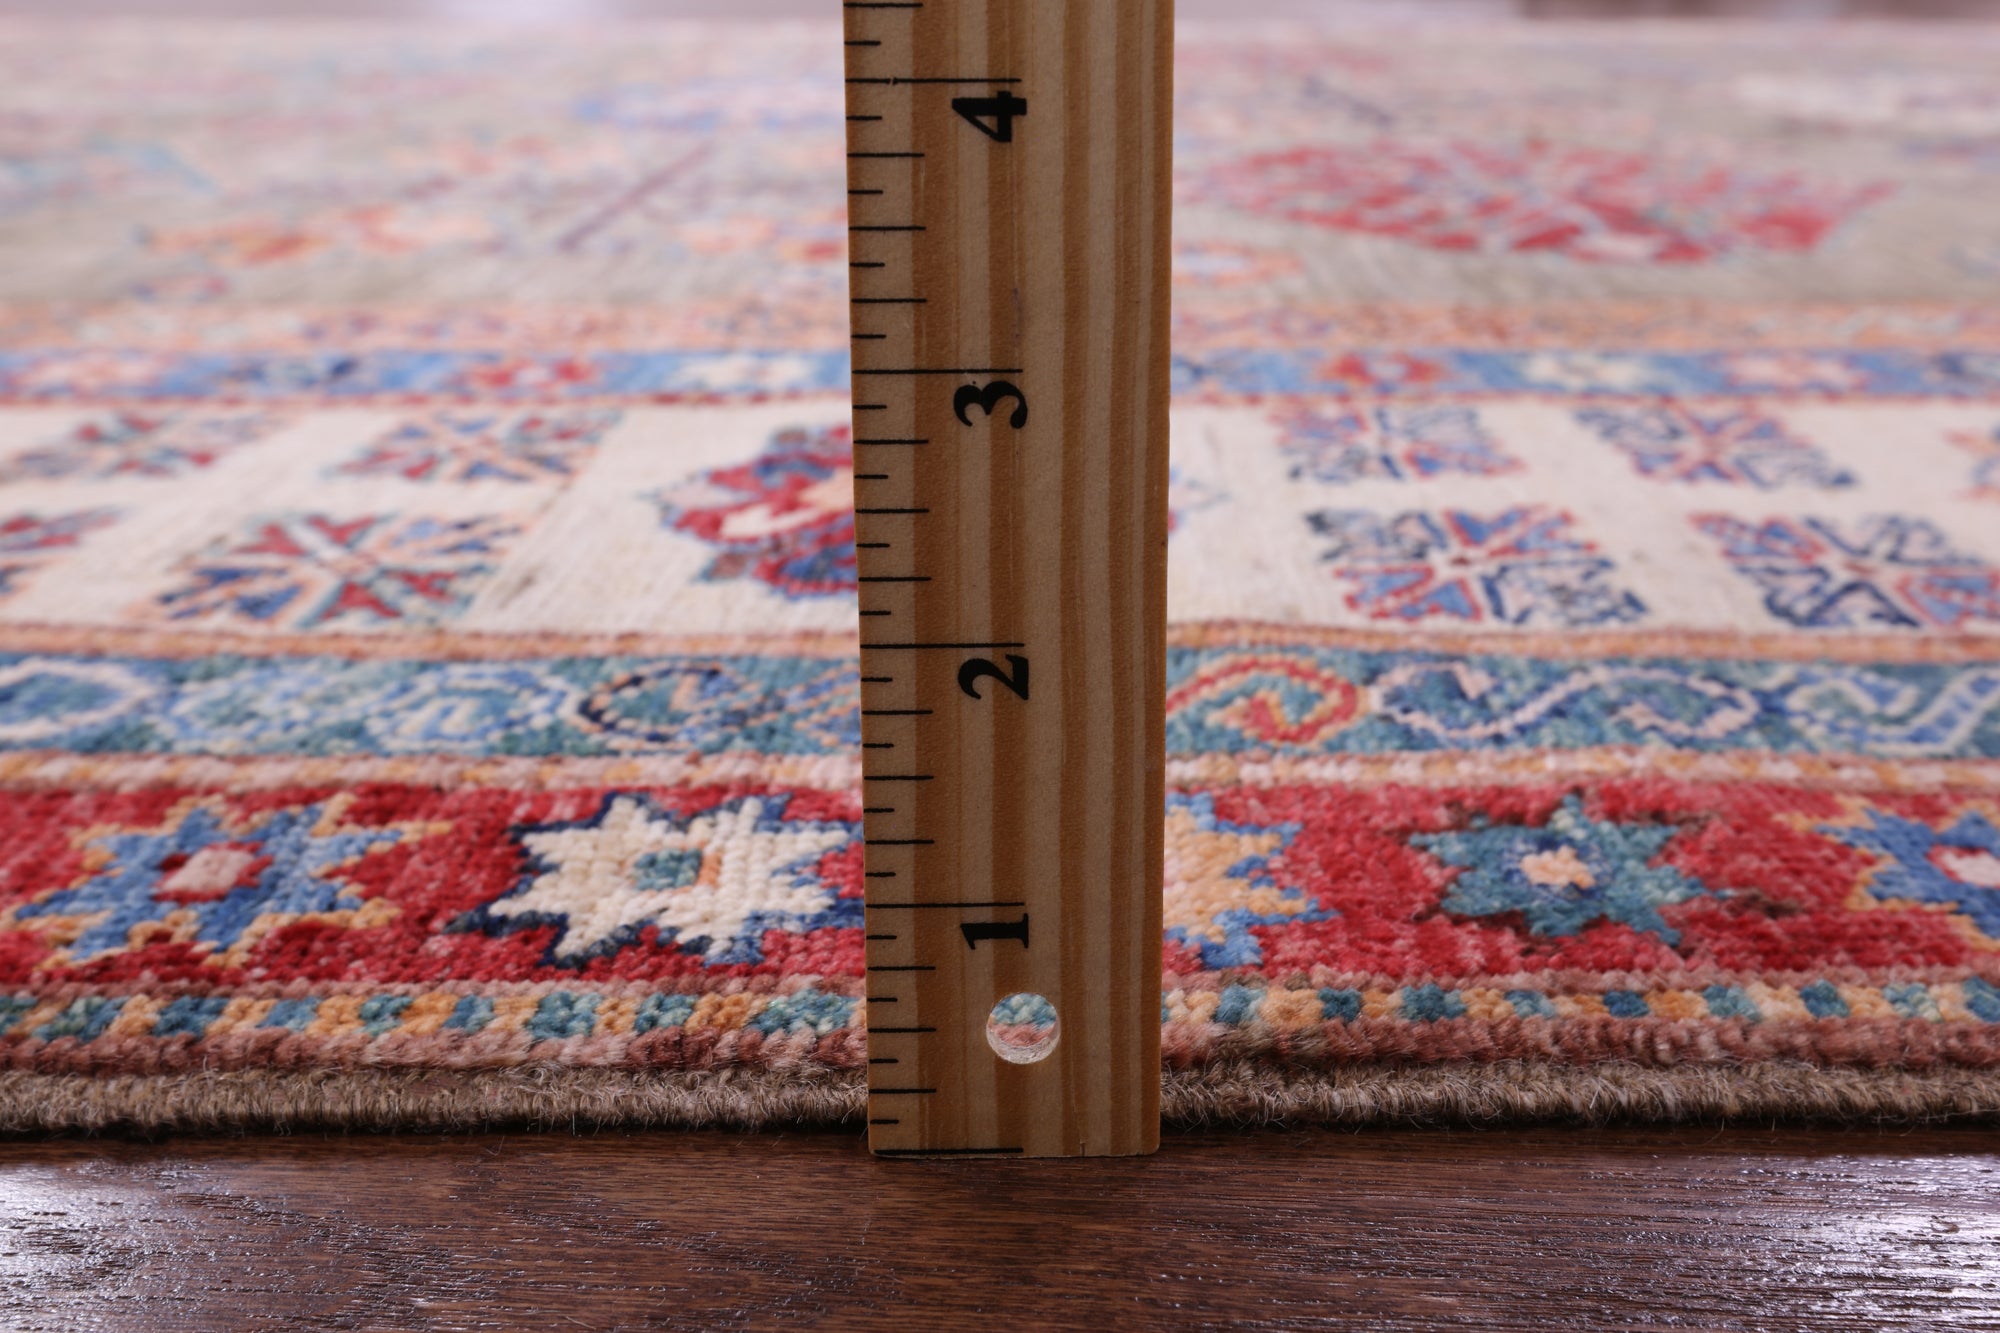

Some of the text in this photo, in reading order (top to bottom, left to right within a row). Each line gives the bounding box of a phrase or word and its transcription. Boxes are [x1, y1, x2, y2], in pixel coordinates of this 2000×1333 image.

[951, 90, 1027, 143] 4
[953, 380, 1028, 430] 3
[957, 653, 1029, 701] 2
[960, 912, 1029, 950] 1
